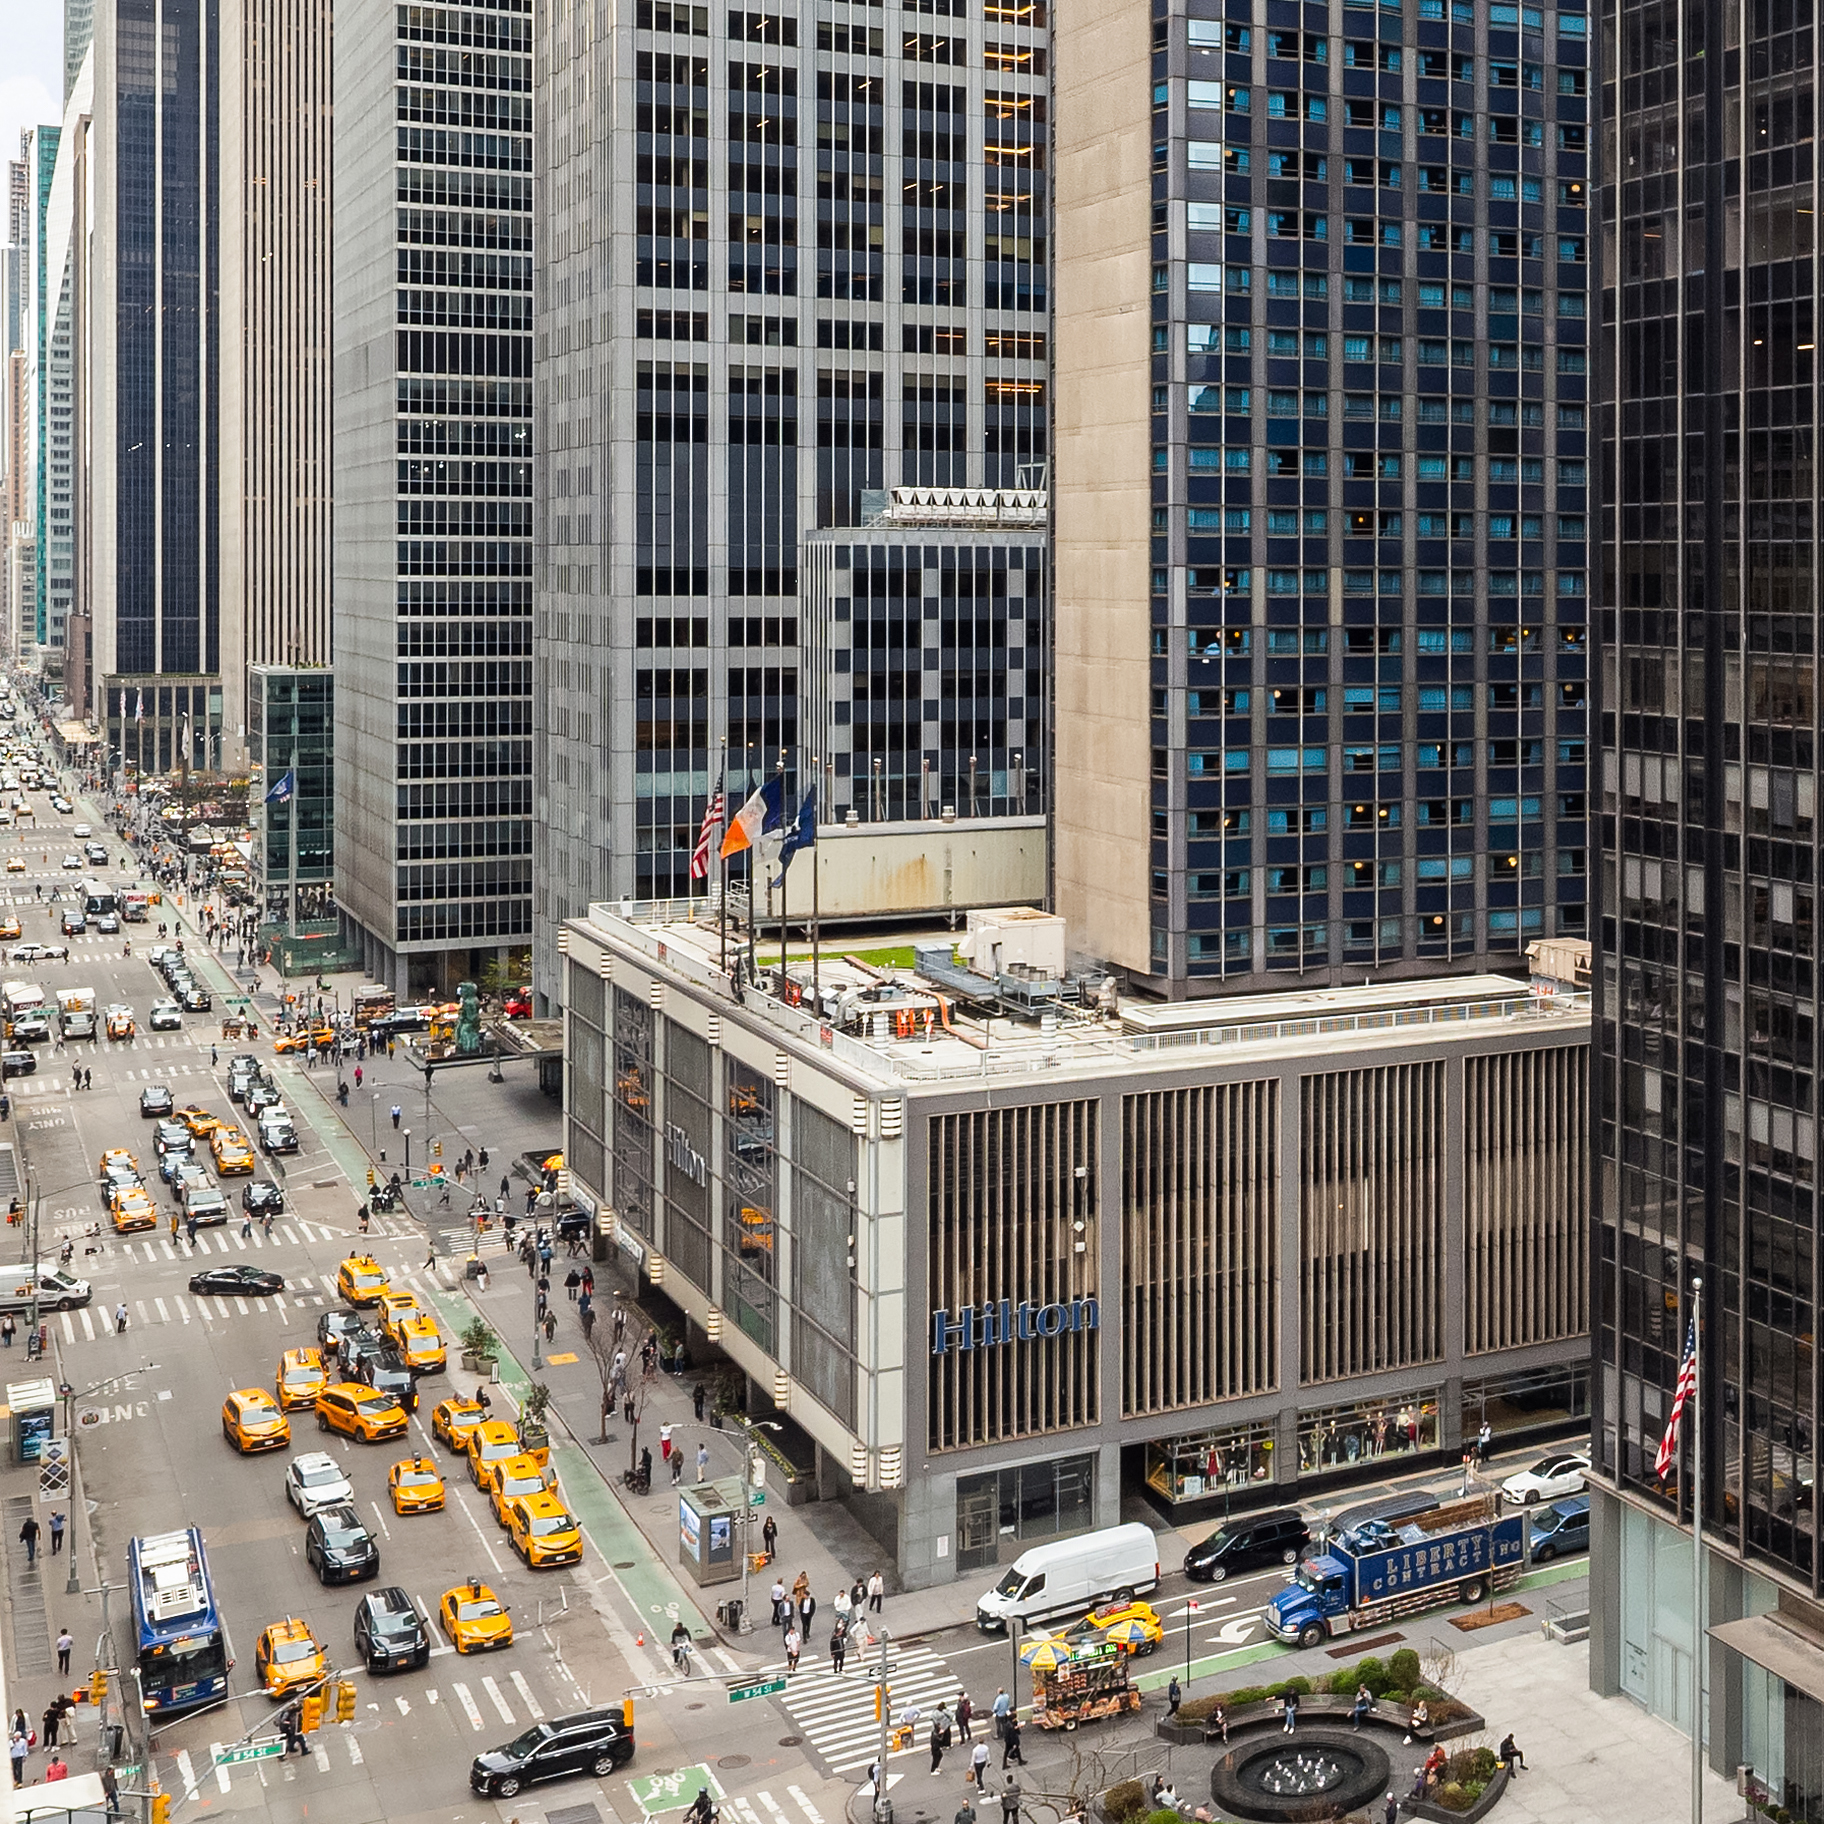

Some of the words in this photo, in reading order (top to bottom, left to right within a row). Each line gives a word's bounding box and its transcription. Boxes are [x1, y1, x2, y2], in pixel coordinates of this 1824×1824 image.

[28, 1118, 66, 1131] ONLY
[666, 1121, 706, 1188] Hilton
[932, 1298, 1101, 1355] Hilton
[1373, 1539, 1521, 1591] CONTRACTING
[1387, 1534, 1484, 1575] LIBERTY
[743, 1689, 751, 1698] W
[752, 1687, 762, 1697] 54
[763, 1684, 773, 1693] St
[233, 1752, 241, 1761] W
[243, 1749, 255, 1760] 54
[256, 1747, 267, 1757] St
